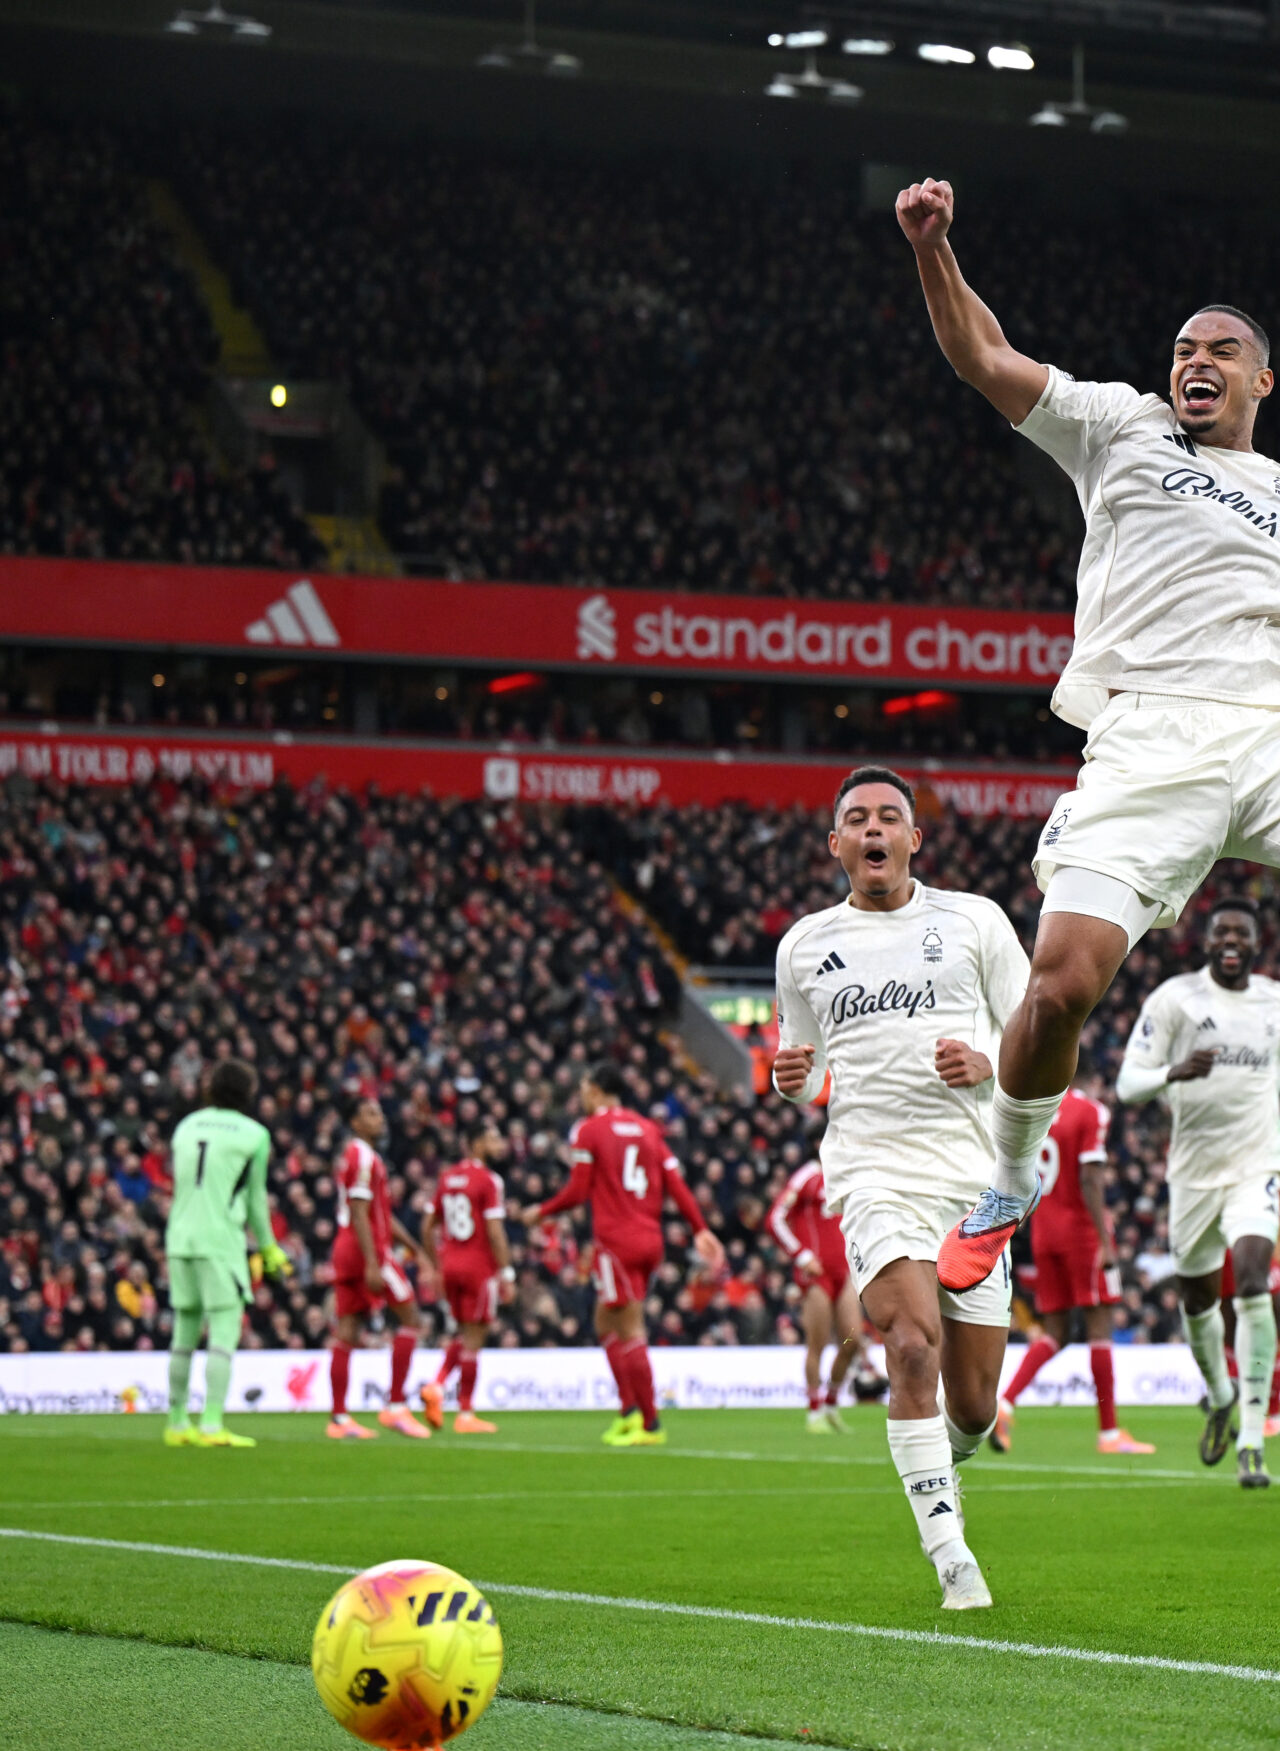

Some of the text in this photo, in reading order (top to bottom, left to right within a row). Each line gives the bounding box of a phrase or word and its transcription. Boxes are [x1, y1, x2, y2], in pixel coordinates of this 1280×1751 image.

[634, 606, 1074, 676] standard charte
[57, 744, 129, 783] TOUR
[524, 763, 661, 803] STORE APP
[831, 979, 937, 1024] Bally's
[196, 1140, 208, 1188] 1
[622, 1144, 649, 1200] 4
[442, 1193, 475, 1241] 18
[0, 1385, 121, 1413] ayments
[910, 1477, 948, 1494] NFFC
